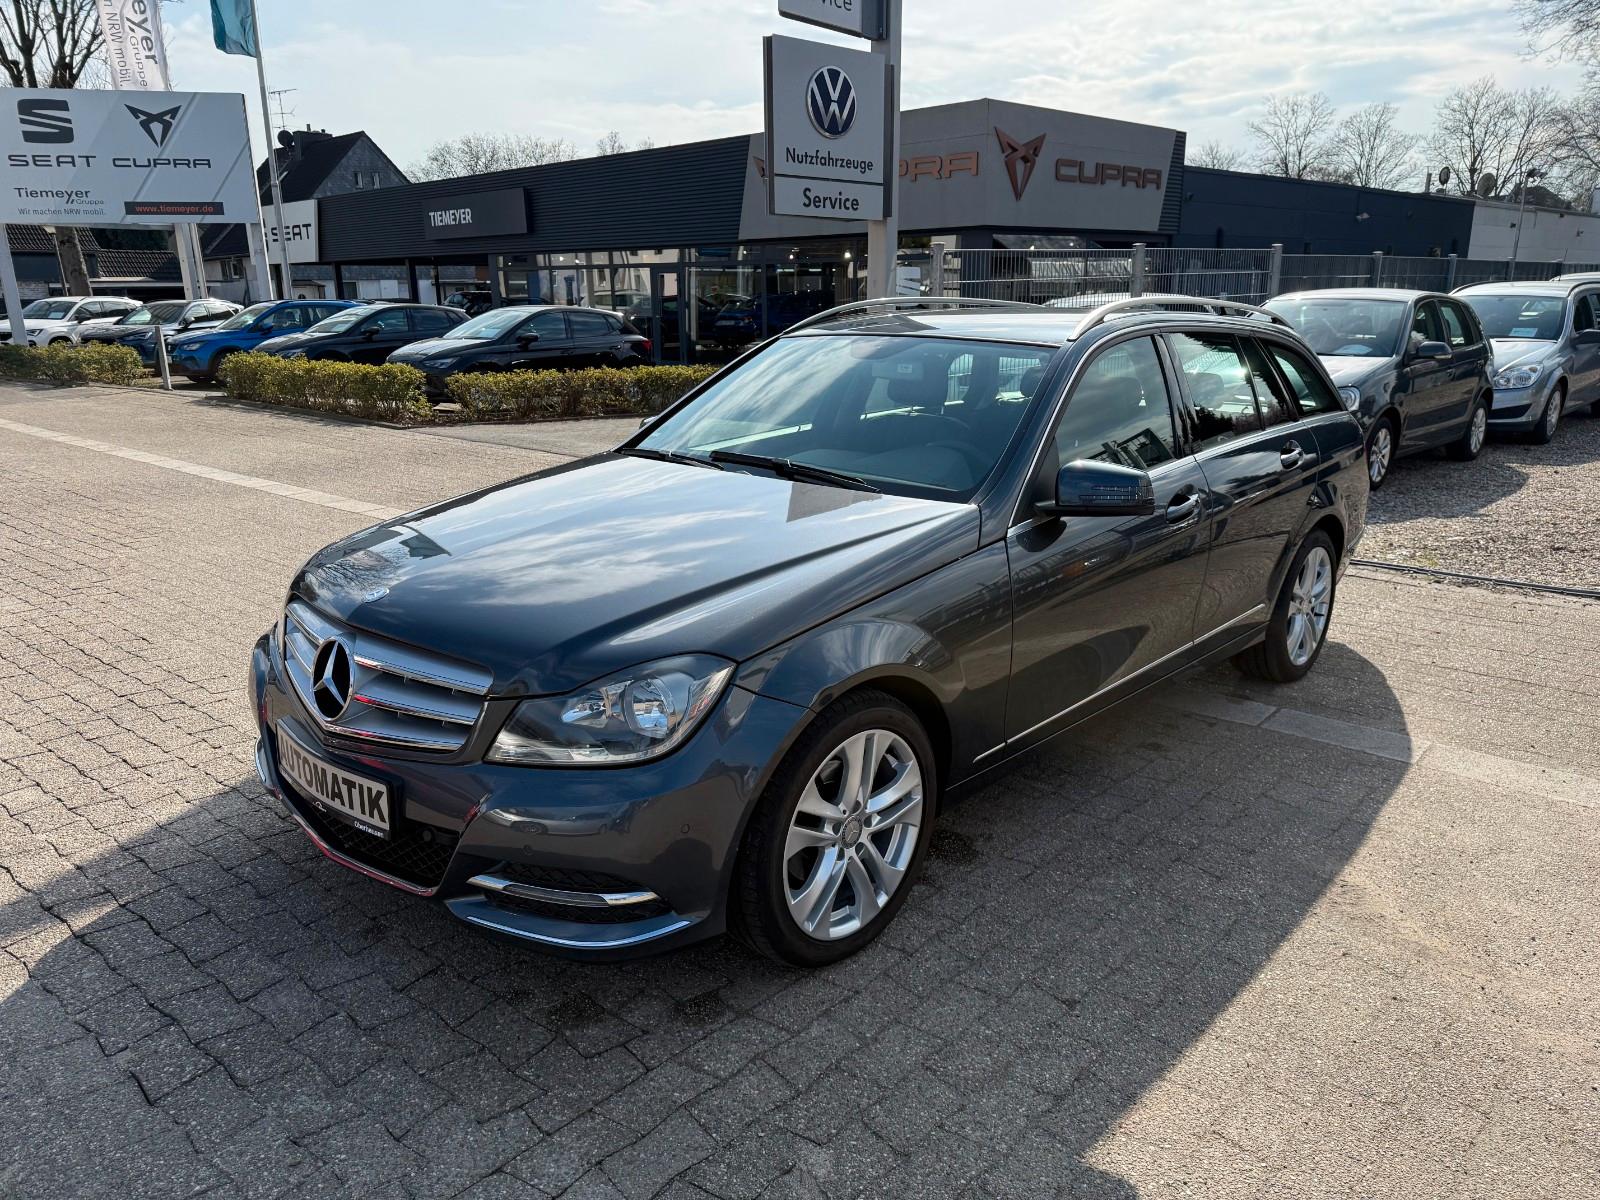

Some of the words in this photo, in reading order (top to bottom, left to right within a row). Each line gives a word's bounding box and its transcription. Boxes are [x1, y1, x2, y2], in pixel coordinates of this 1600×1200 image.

[105, 12, 123, 43] NRW
[126, 0, 158, 64] eyer
[113, 48, 131, 87] mobil.
[130, 36, 148, 87] Gruppe
[8, 154, 97, 168] SEAT
[112, 157, 212, 169] CUPRA
[785, 146, 874, 174] Nutzfahrzeuge
[1055, 158, 1162, 190] CUPRA
[13, 187, 91, 204] Tiemeyer
[802, 187, 860, 211] Service
[63, 207, 81, 215] NRW
[135, 204, 214, 213] www.tiemeyer.de
[428, 208, 473, 228] TIEMEYER
[270, 223, 312, 243] SEAT
[280, 734, 387, 824] AUTOMATIK
